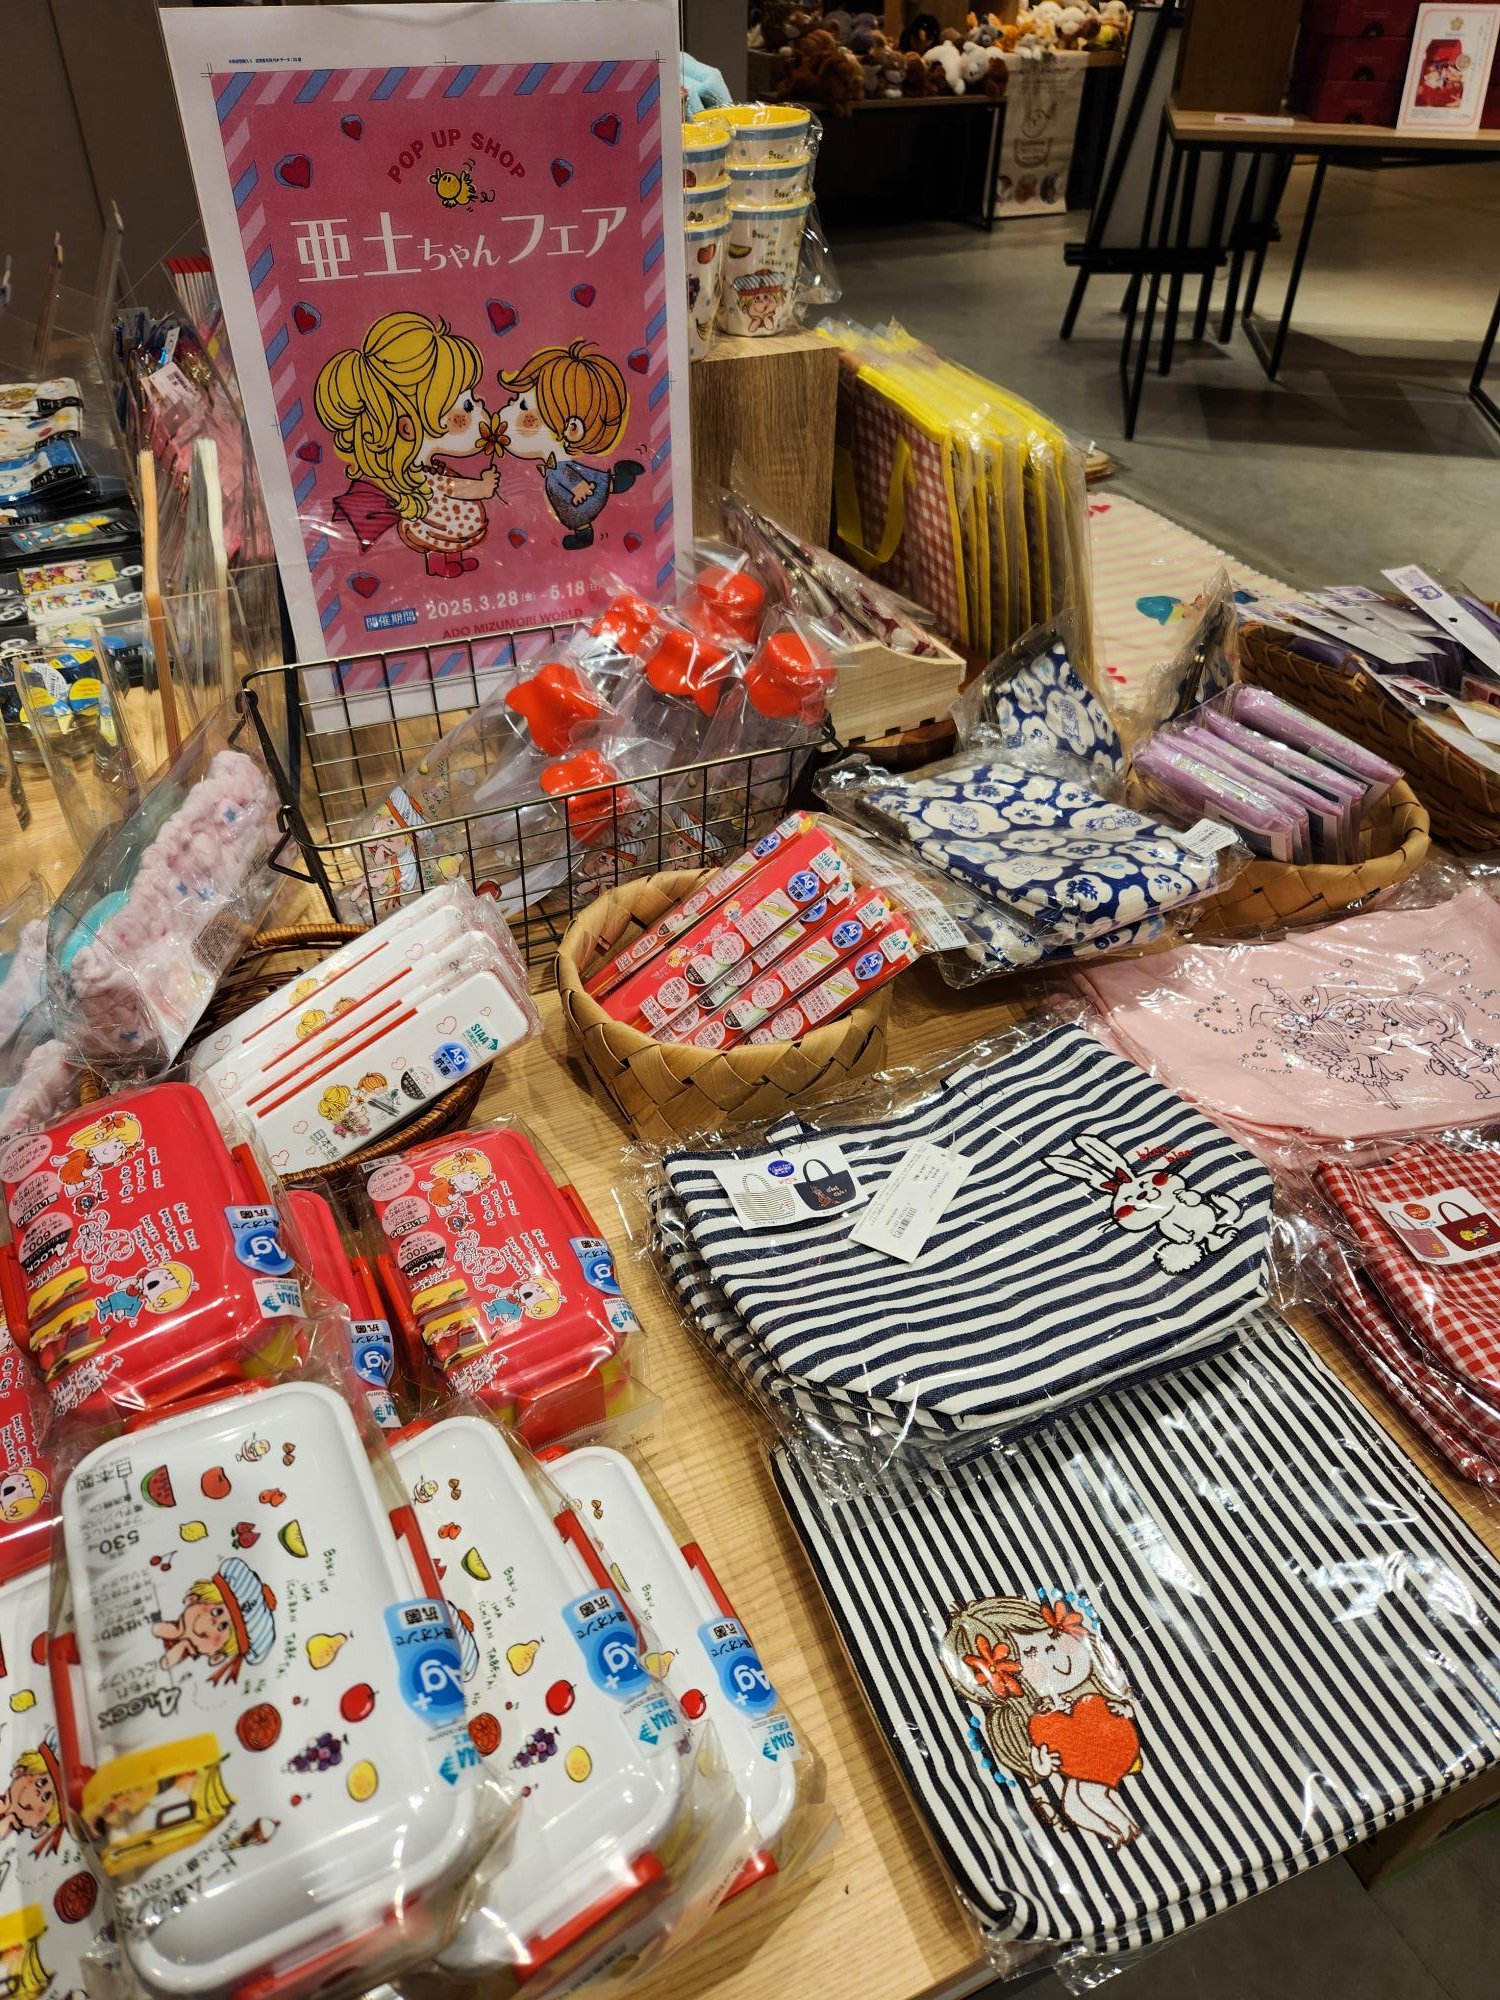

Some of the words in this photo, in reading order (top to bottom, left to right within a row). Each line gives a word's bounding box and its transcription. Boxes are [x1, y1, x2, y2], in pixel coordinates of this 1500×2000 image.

[388, 139, 425, 184] POP
[431, 128, 461, 149] UP
[470, 132, 526, 179] SHOP
[289, 206, 628, 283] 亜土ちゃんフェア
[365, 608, 417, 631] 開催期間
[443, 626, 470, 640] ADO
[473, 614, 540, 636] MIZUMORI
[540, 608, 584, 624] WORLD
[801, 874, 816, 890] Ag
[846, 923, 858, 937] Ag
[867, 954, 879, 968] Ag
[470, 1022, 491, 1045] SIAA
[434, 1057, 452, 1077] 抗菌
[448, 1045, 468, 1067] Ag
[314, 1128, 341, 1160] 日本製
[239, 1208, 268, 1219] 抗菌
[25, 1242, 67, 1274] 4LOCK
[576, 1249, 610, 1257] イオンで
[406, 1256, 444, 1277] 4LOCK
[277, 1292, 301, 1307] SIAA
[355, 1323, 379, 1333] 抗菌
[75, 1461, 132, 1492] 日本製
[403, 1603, 439, 1627] 抗菌
[578, 1594, 609, 1618] 抗菌
[723, 1657, 773, 1708] Ag+
[97, 1686, 182, 1730] 4LOCK
[649, 1708, 677, 1732] SIAA
[770, 1731, 796, 1753] SIAA
